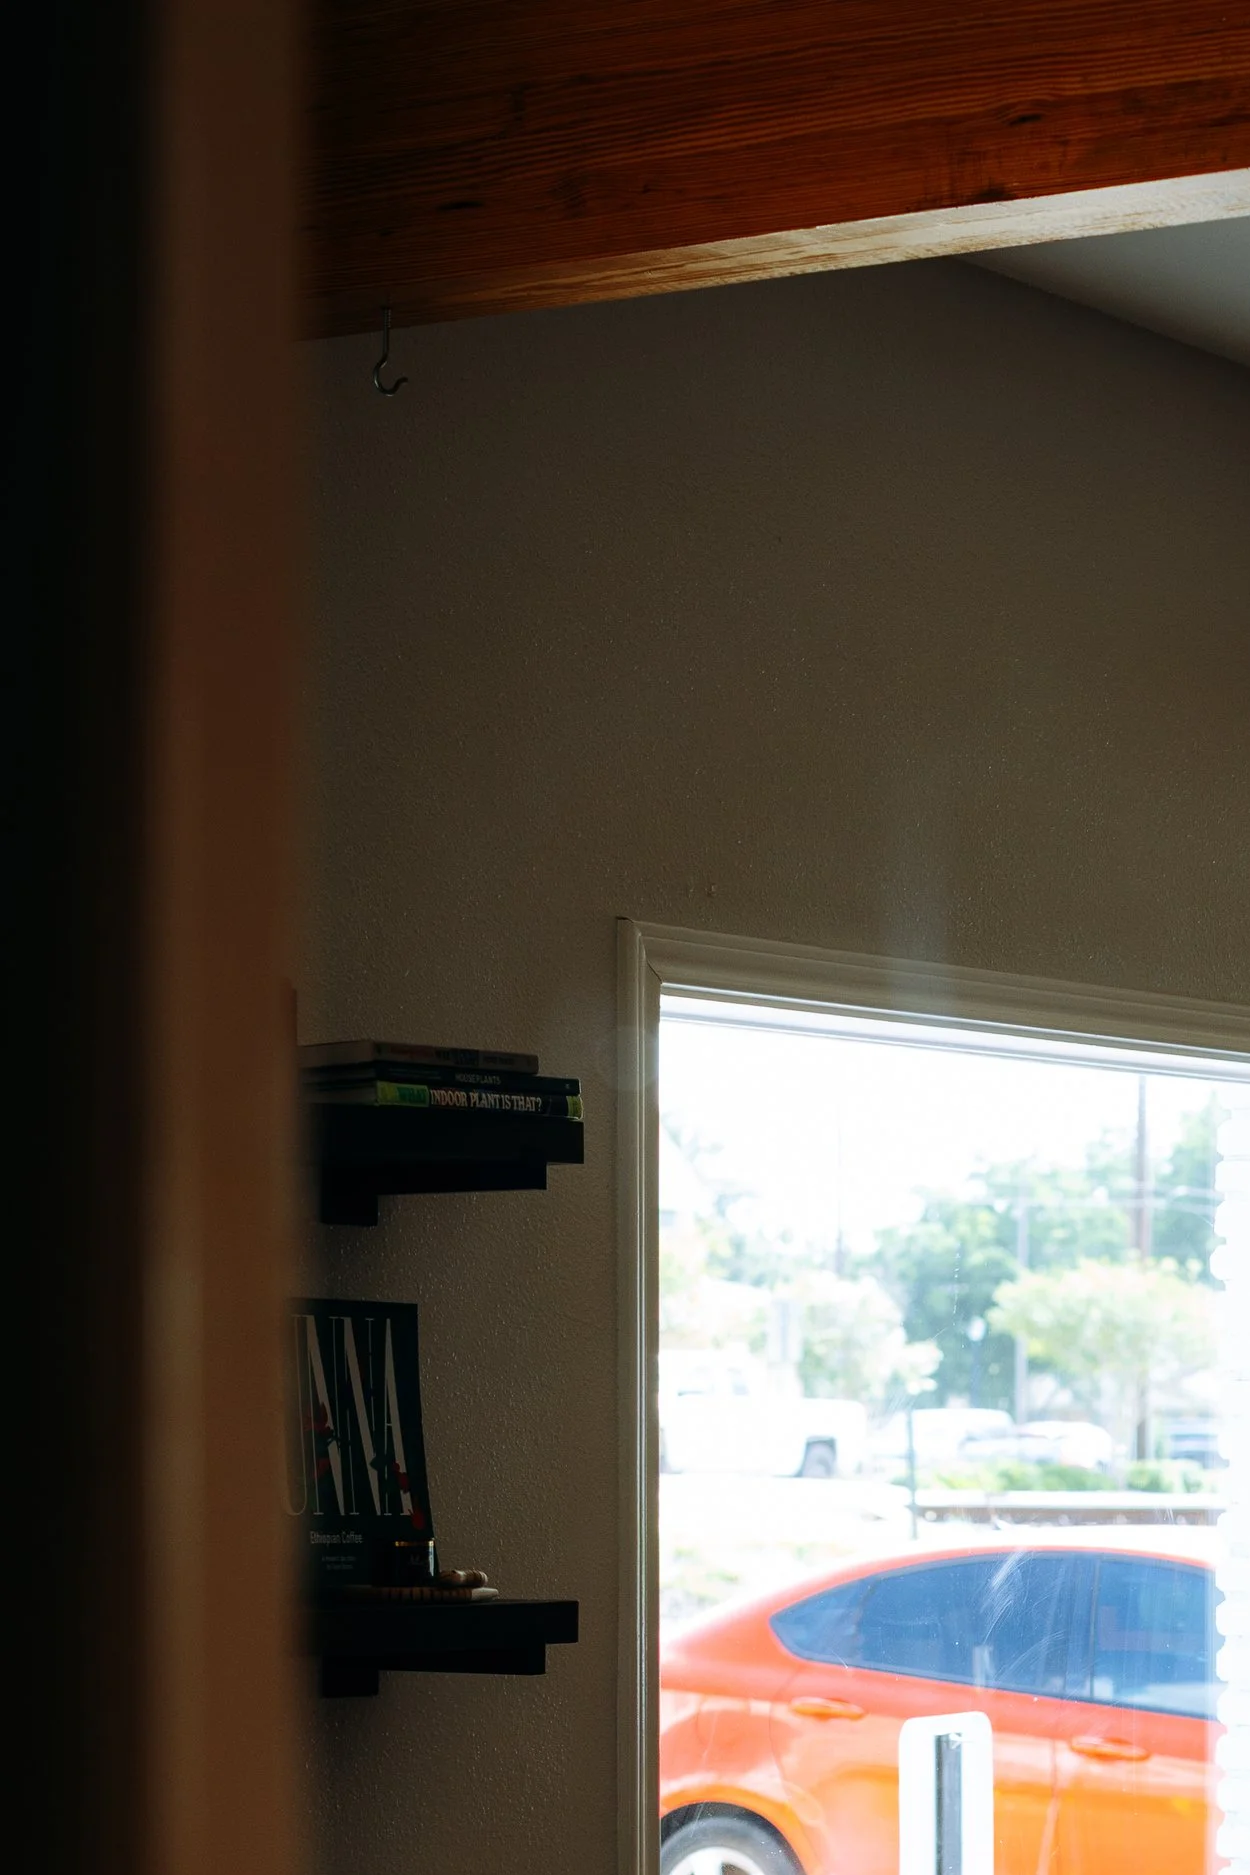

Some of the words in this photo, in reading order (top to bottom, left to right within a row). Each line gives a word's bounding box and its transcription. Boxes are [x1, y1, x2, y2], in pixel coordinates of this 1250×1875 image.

[430, 1089, 468, 1107] INDOOR
[469, 1091, 500, 1109] PLANT
[501, 1094, 511, 1110] IS
[511, 1095, 543, 1112] THAT?
[341, 1531, 363, 1545] Coffee
